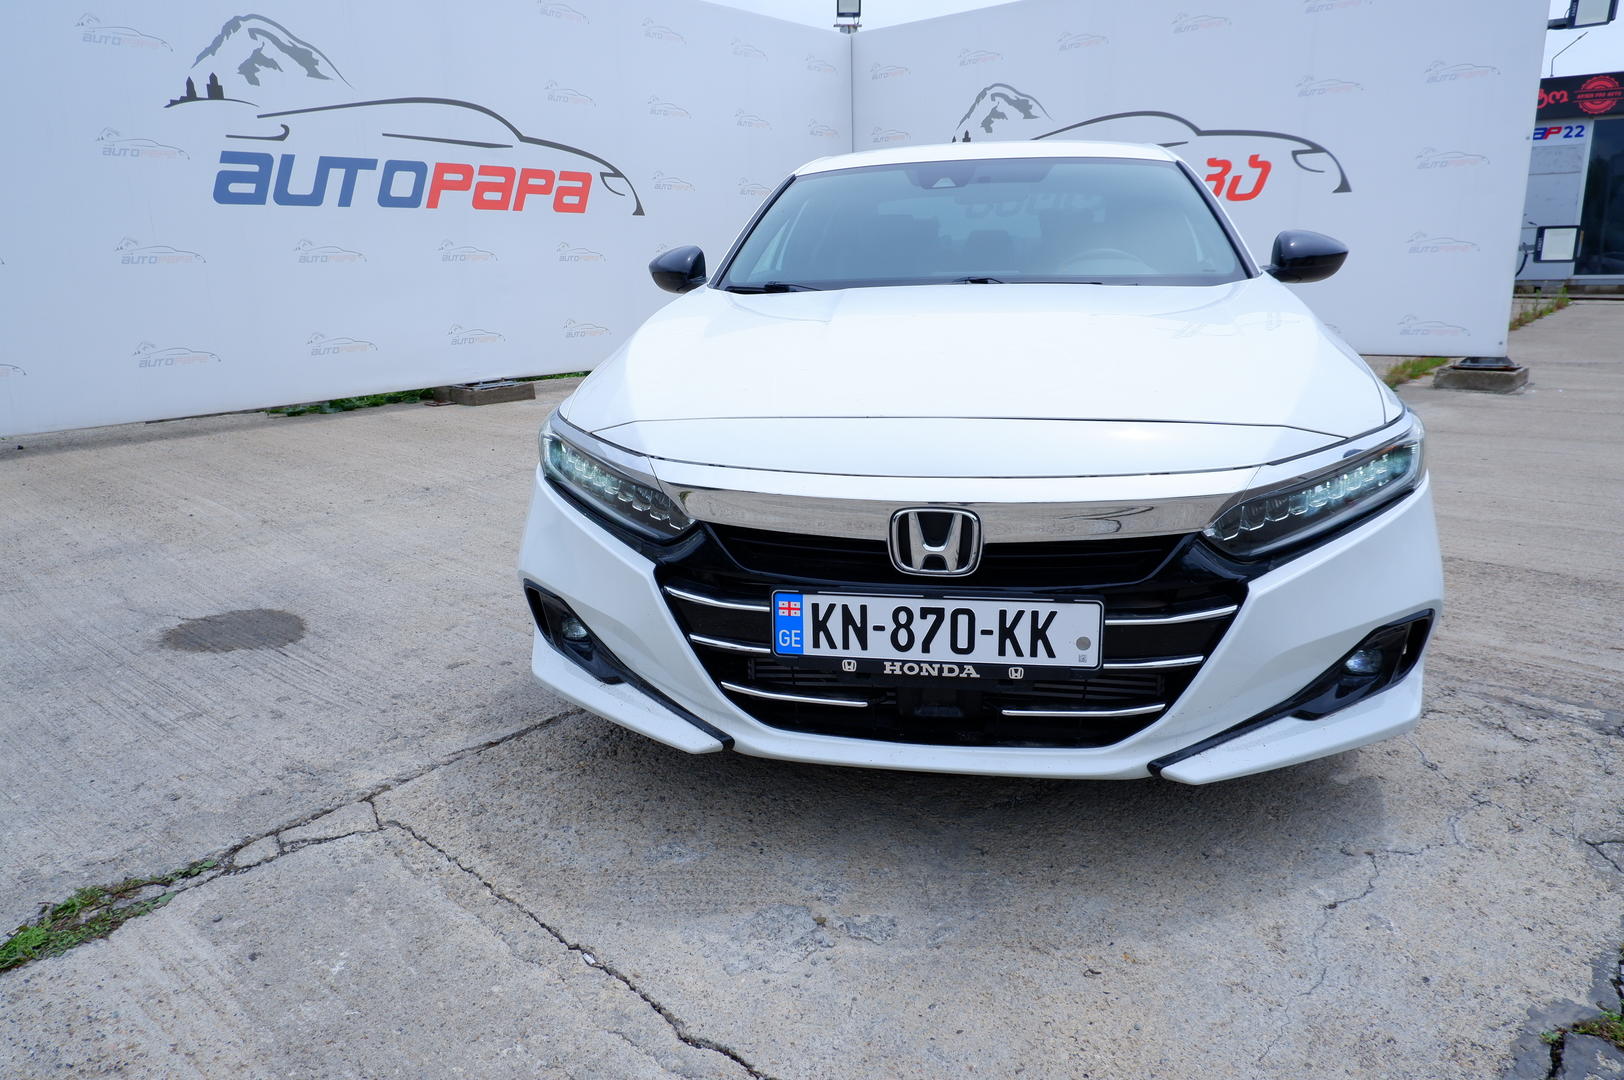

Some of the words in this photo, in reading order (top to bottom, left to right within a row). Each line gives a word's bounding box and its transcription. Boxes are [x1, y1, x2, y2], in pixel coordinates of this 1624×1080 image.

[1563, 125, 1585, 139] 22
[779, 629, 801, 647] GE
[811, 602, 1058, 659] KN-870-KK
[883, 661, 980, 679] HONDA
